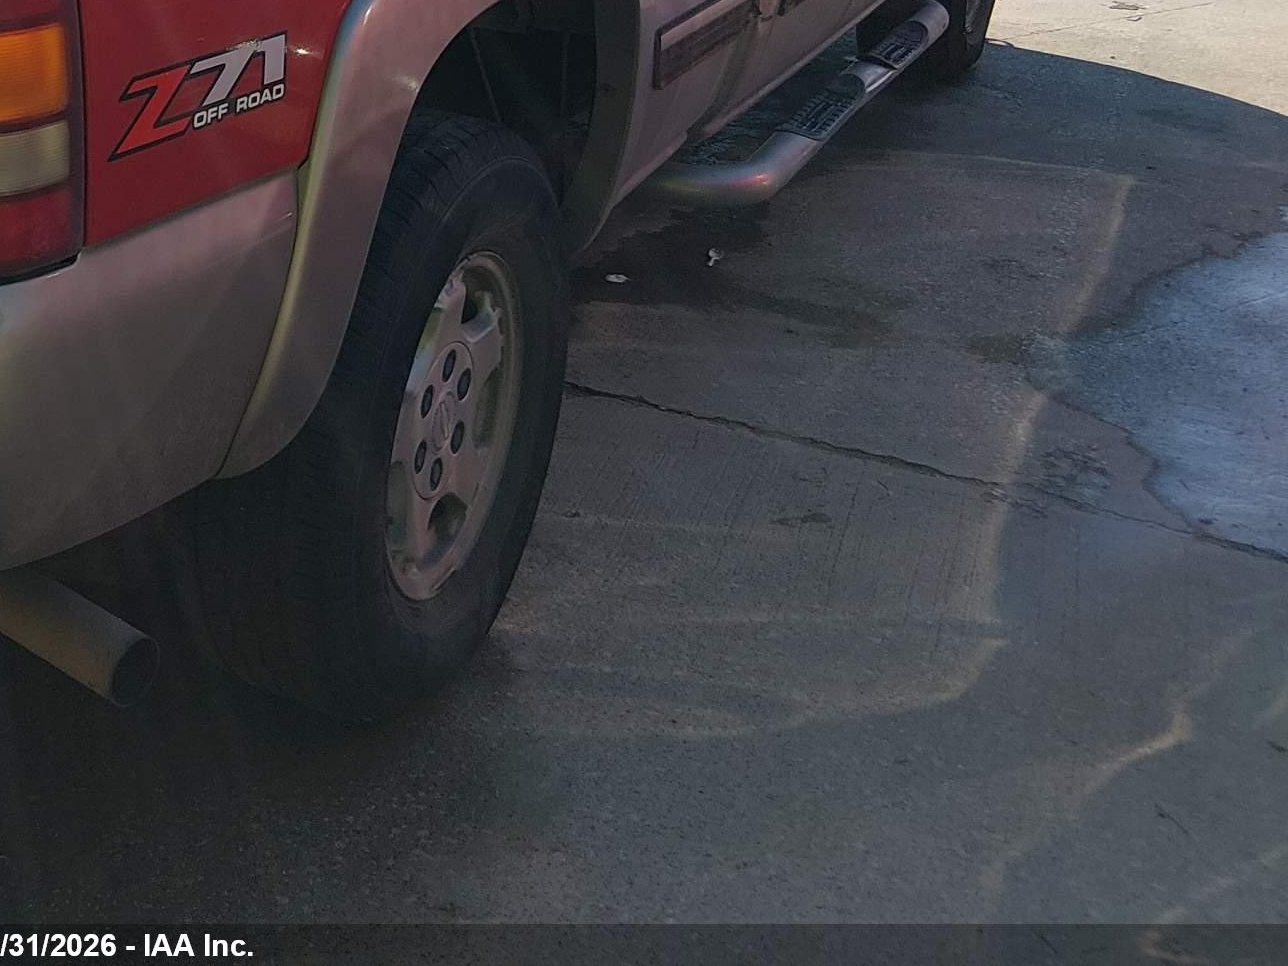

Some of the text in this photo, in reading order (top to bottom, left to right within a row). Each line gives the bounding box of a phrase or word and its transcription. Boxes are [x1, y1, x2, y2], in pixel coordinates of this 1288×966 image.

[108, 31, 288, 162] Z71
[192, 83, 285, 129] OFF ROAD
